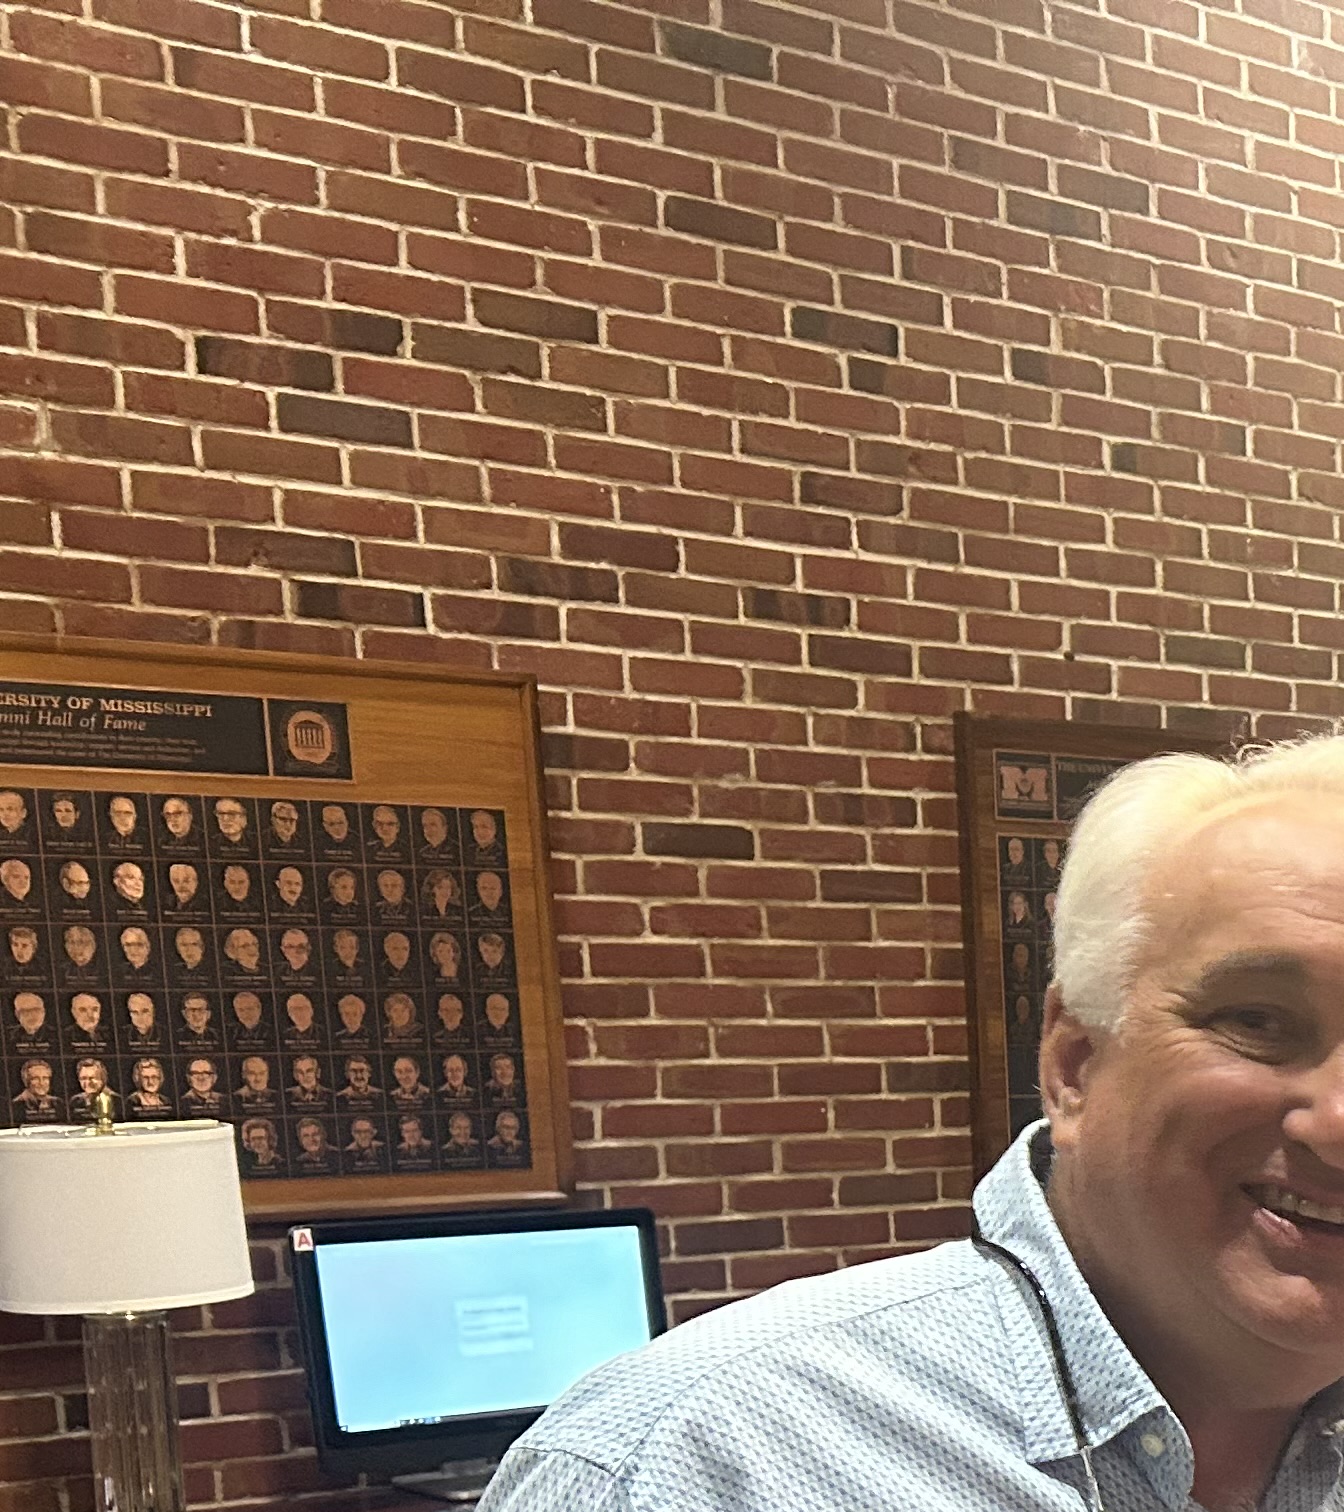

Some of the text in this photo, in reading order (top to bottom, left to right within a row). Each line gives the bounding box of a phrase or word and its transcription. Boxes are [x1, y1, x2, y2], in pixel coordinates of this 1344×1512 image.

[66, 696, 94, 711] OF
[100, 698, 213, 718] MISSISSIPPI
[38, 710, 72, 727] Hall
[79, 713, 97, 731] of
[103, 715, 147, 731] Fame
[298, 1232, 311, 1248] A
